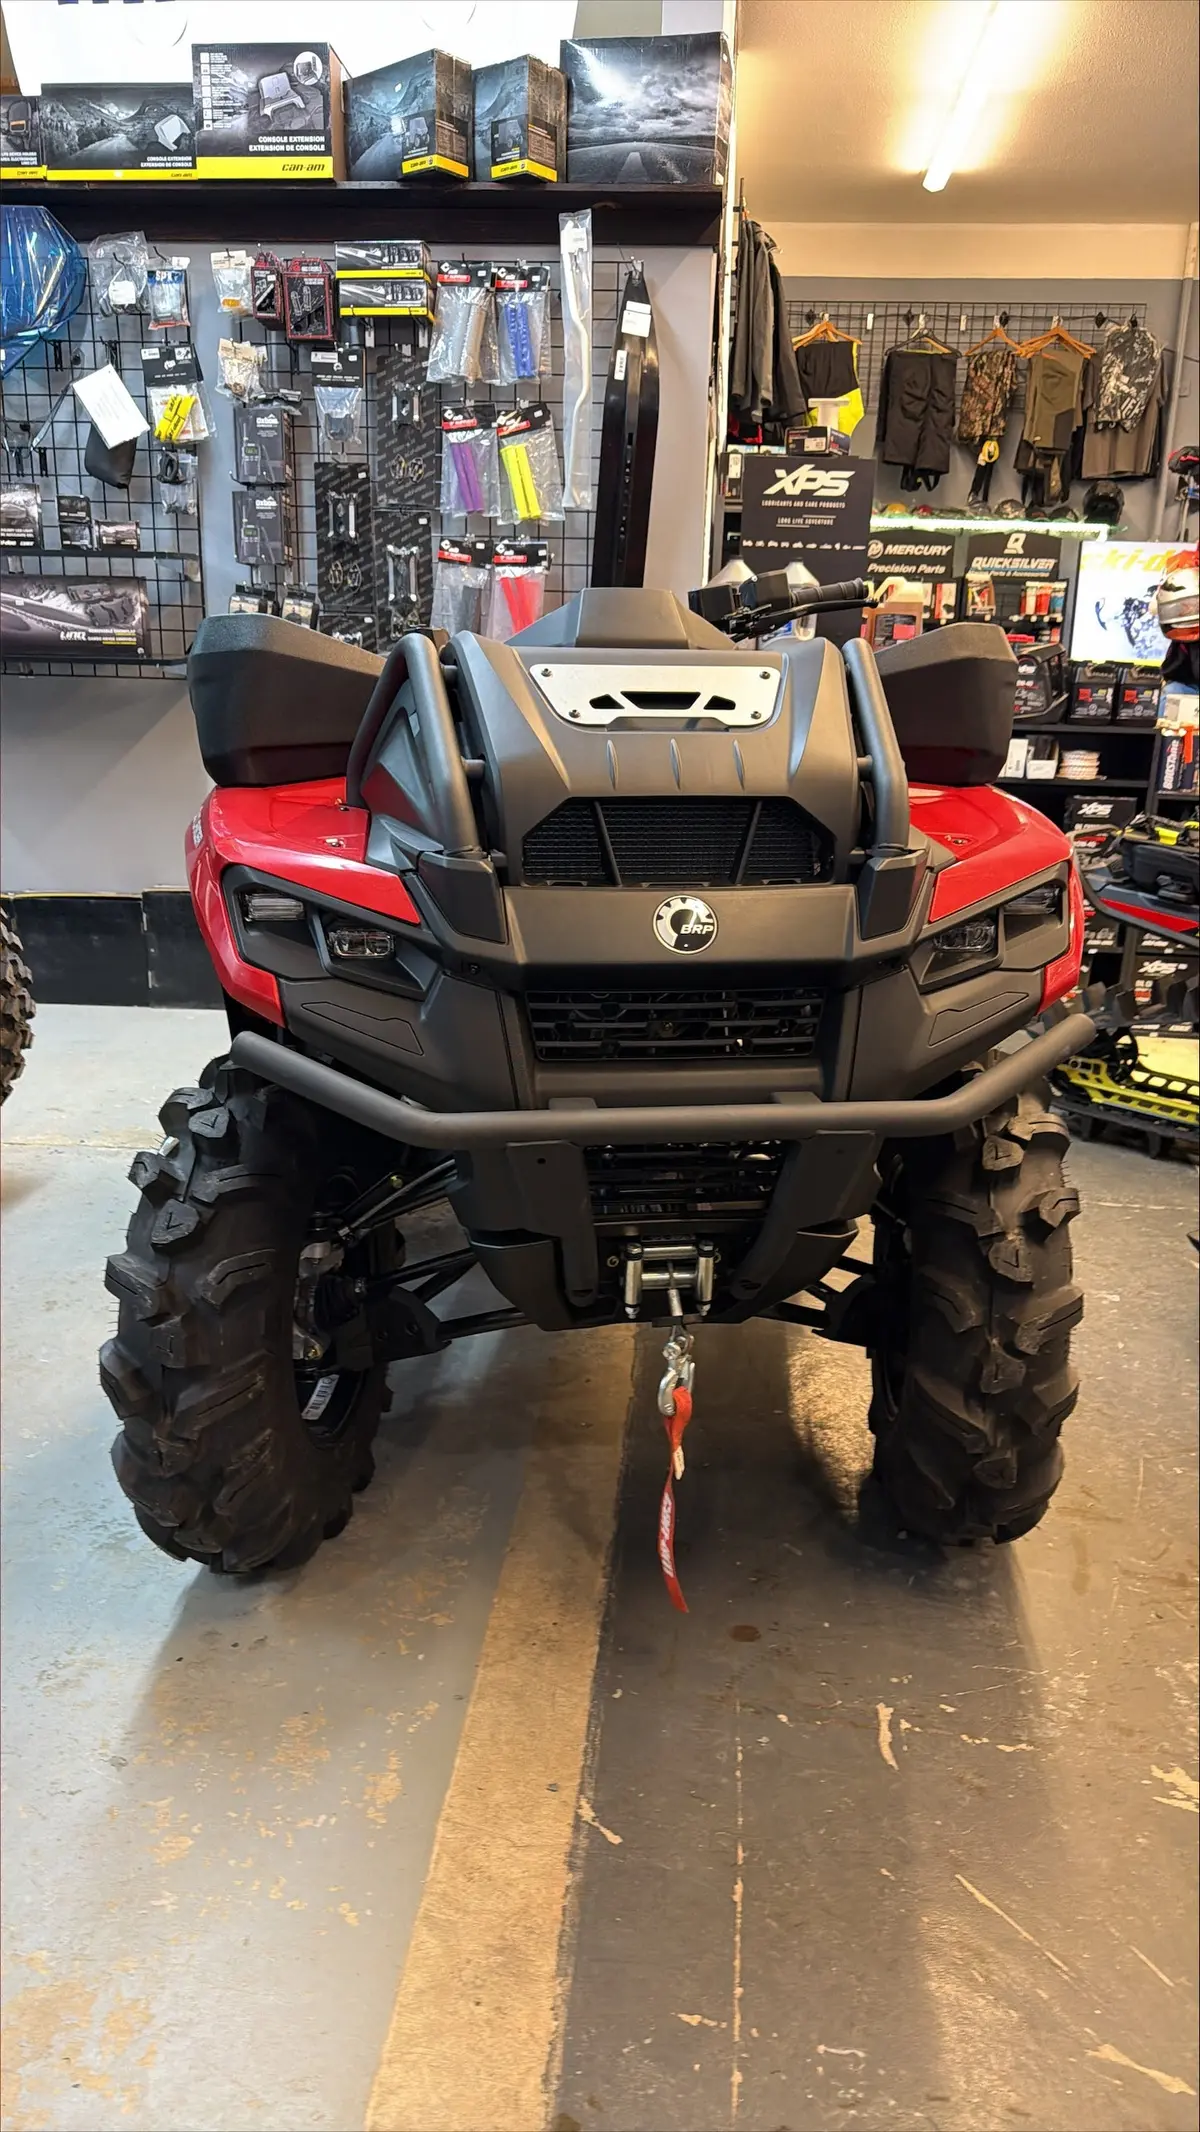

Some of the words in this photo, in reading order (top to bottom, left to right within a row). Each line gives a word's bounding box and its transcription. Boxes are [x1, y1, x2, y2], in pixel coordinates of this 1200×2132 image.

[281, 162, 325, 171] can-am
[763, 464, 855, 497] XPS
[805, 518, 834, 526] ADVENTURE
[884, 544, 952, 555] MERCURY
[867, 563, 916, 573] Precision
[917, 563, 946, 574] Parts
[971, 556, 1056, 570] QUICKSILVER
[1077, 802, 1114, 815] XPS
[680, 924, 714, 935] BRP
[1137, 960, 1178, 974] XPS
